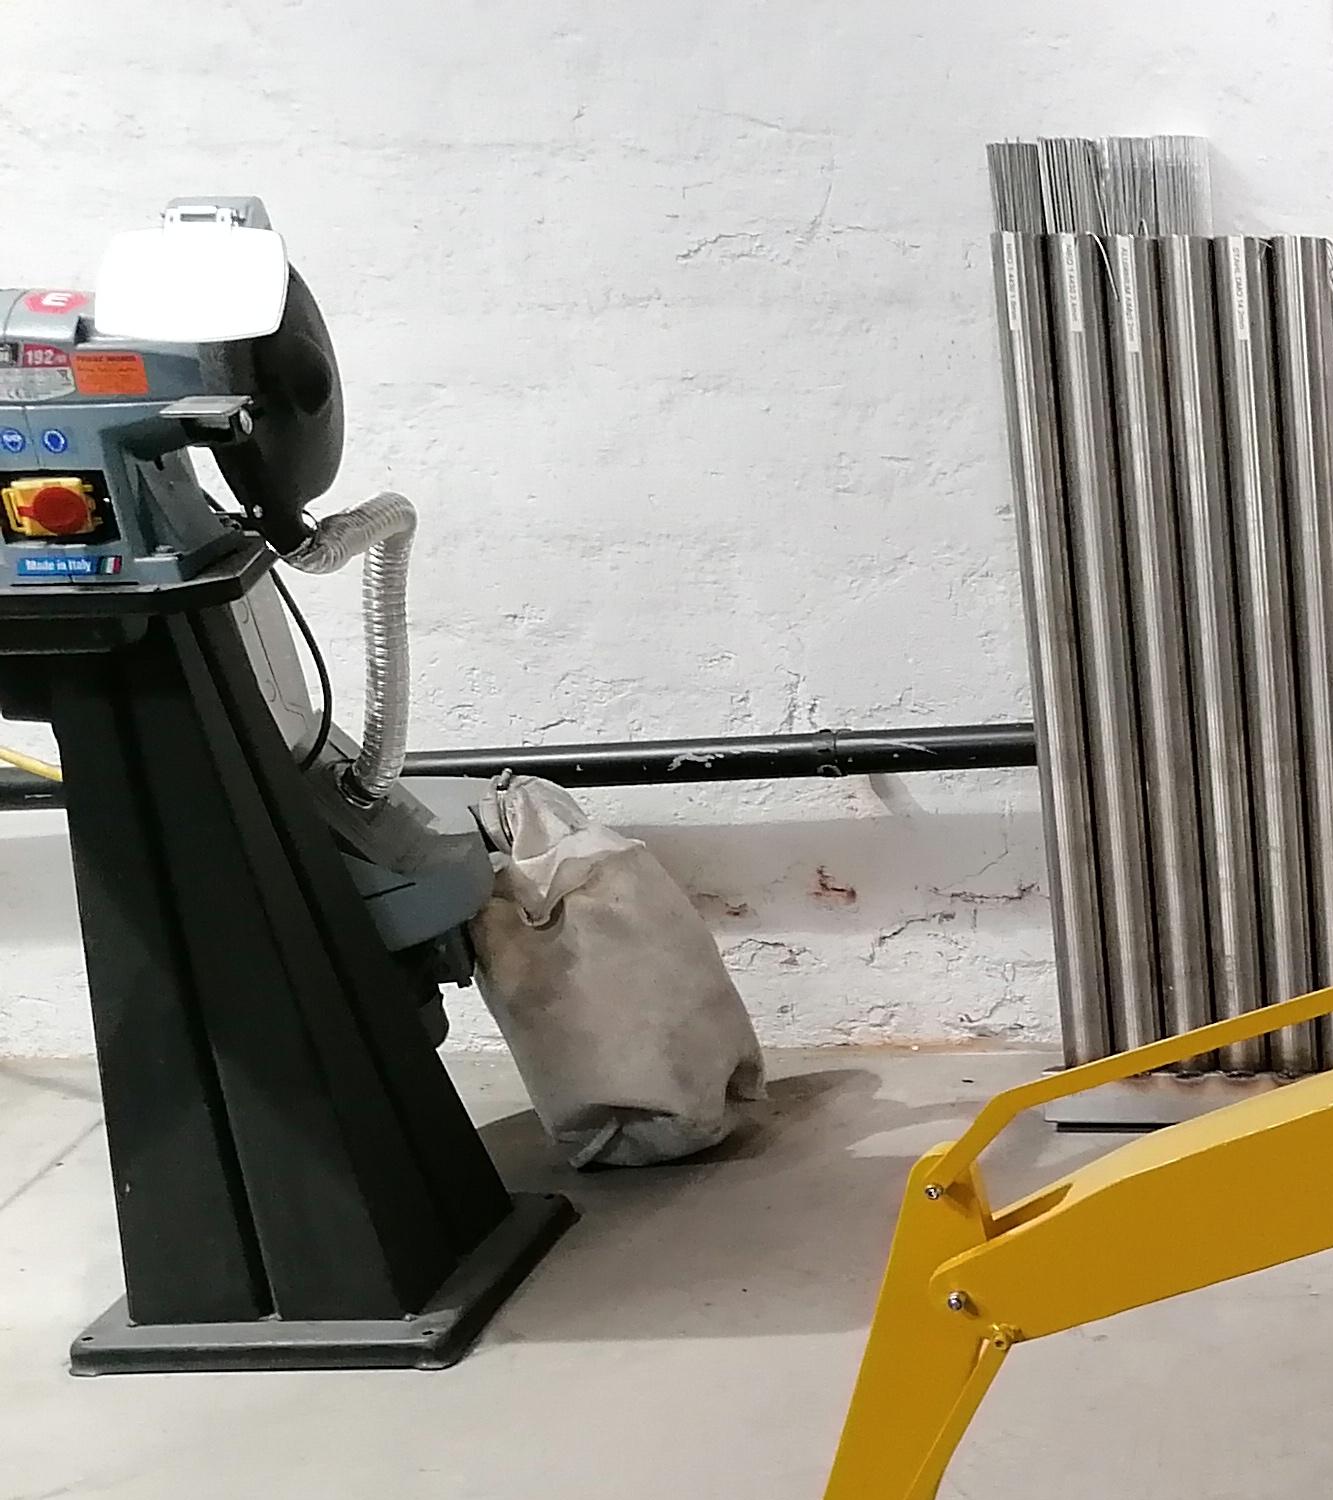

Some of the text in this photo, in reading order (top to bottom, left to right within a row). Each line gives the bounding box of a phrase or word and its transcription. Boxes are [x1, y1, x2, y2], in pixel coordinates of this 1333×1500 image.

[25, 559, 92, 572] Made in Italy
